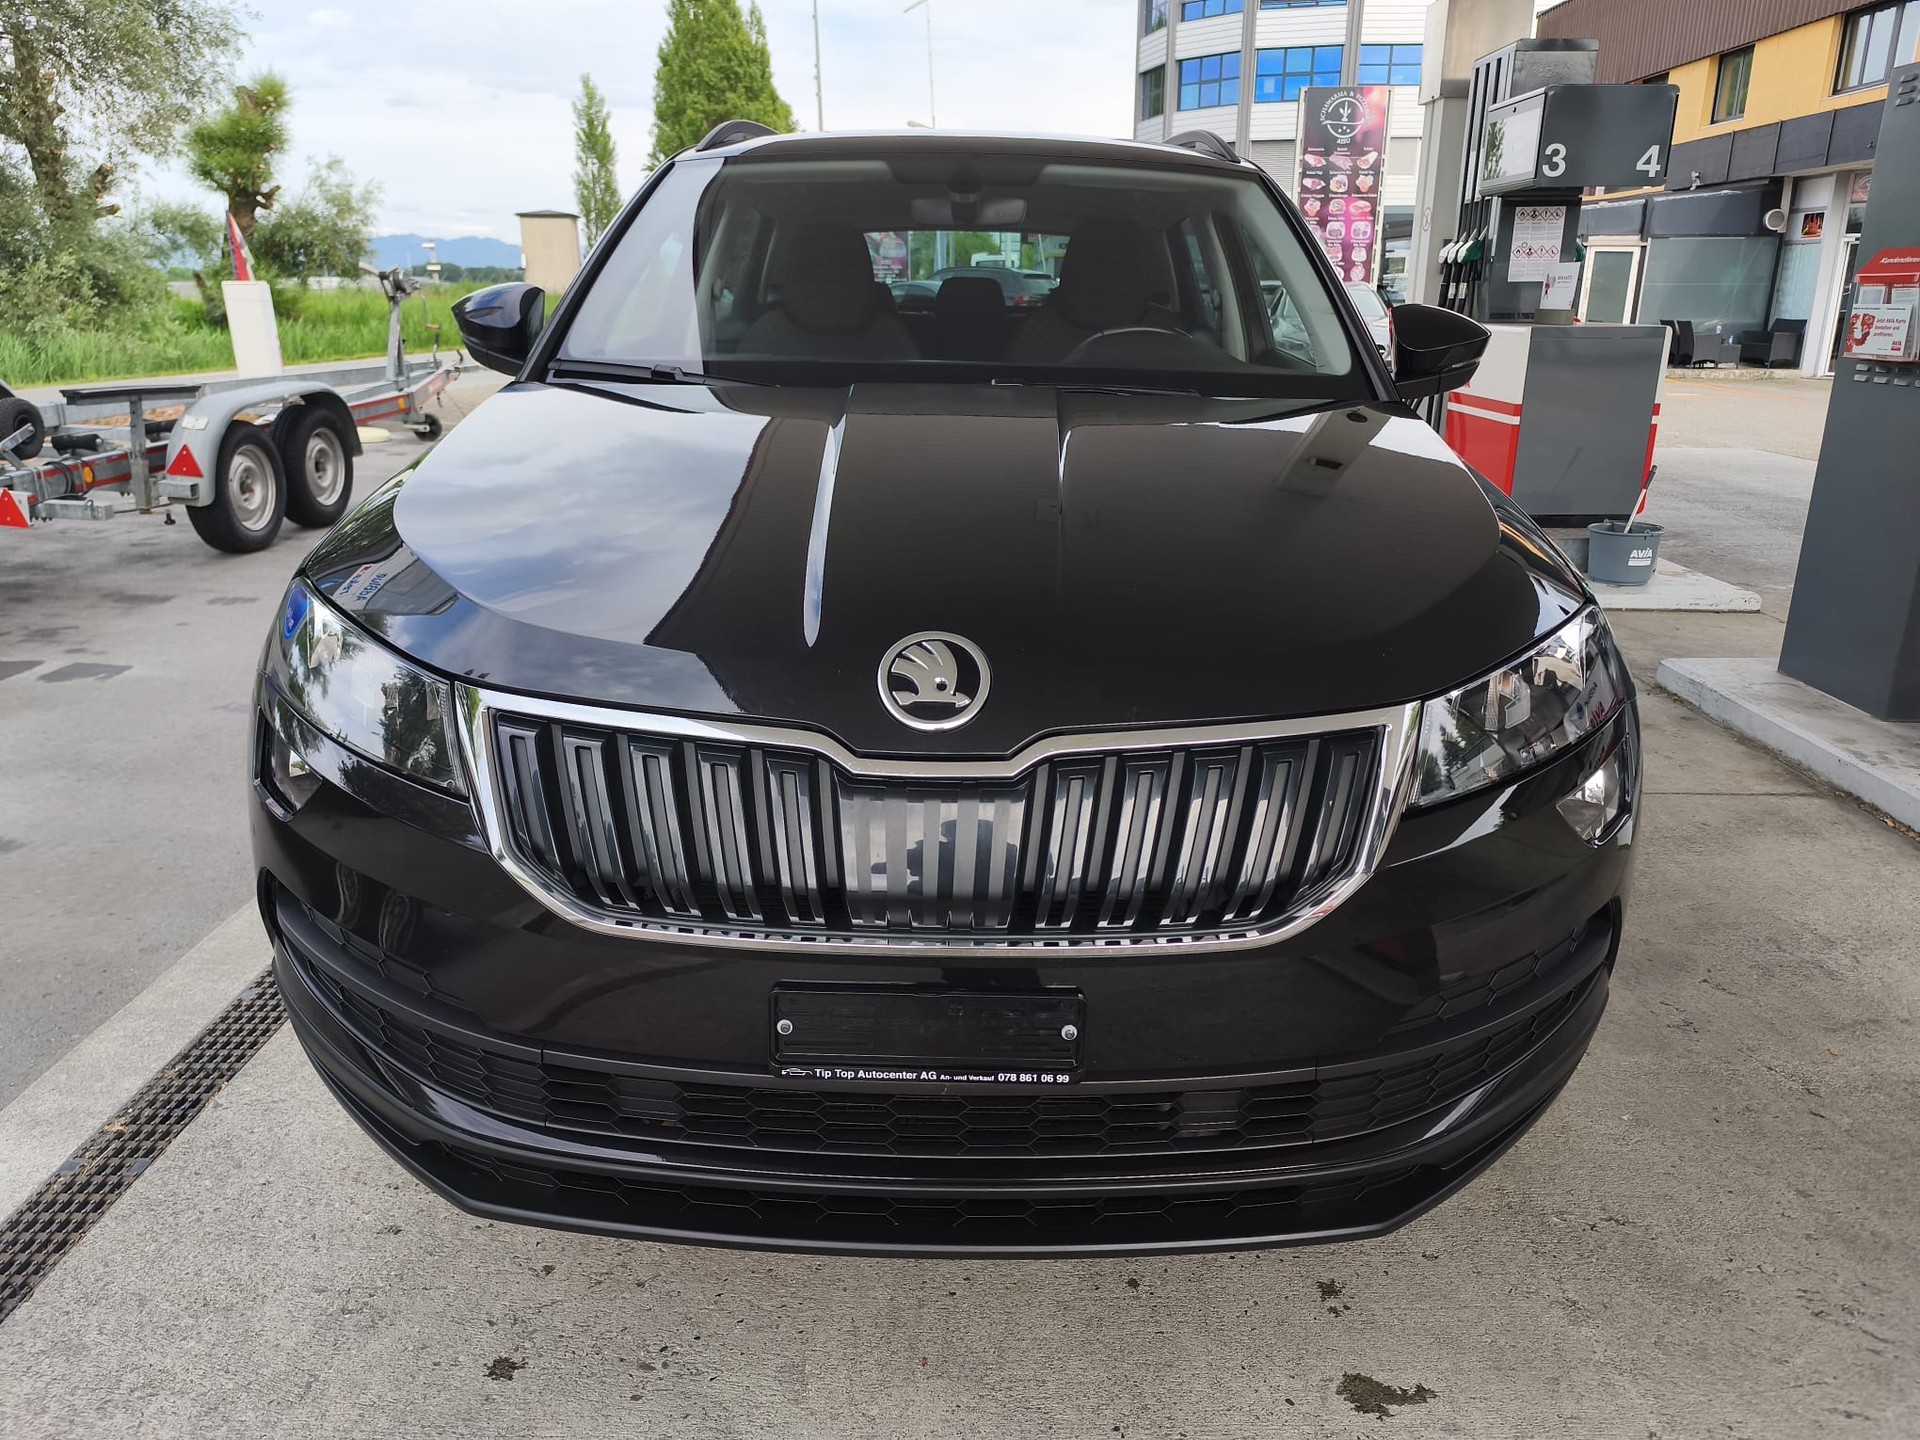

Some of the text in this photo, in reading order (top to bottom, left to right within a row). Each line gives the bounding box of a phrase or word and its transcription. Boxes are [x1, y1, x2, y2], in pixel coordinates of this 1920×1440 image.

[1542, 143, 1567, 178] 3
[1635, 144, 1661, 178] 4
[1629, 547, 1653, 559] AVIA
[814, 1068, 832, 1080] Tip
[834, 1068, 855, 1080] Top
[857, 1069, 917, 1080] Autocenter
[919, 1070, 937, 1080] AG
[968, 1074, 995, 1082] Verkauf
[997, 1073, 1017, 1082] 078
[1019, 1073, 1038, 1083] 861
[1040, 1074, 1054, 1083] 06
[1056, 1075, 1070, 1084] 99
